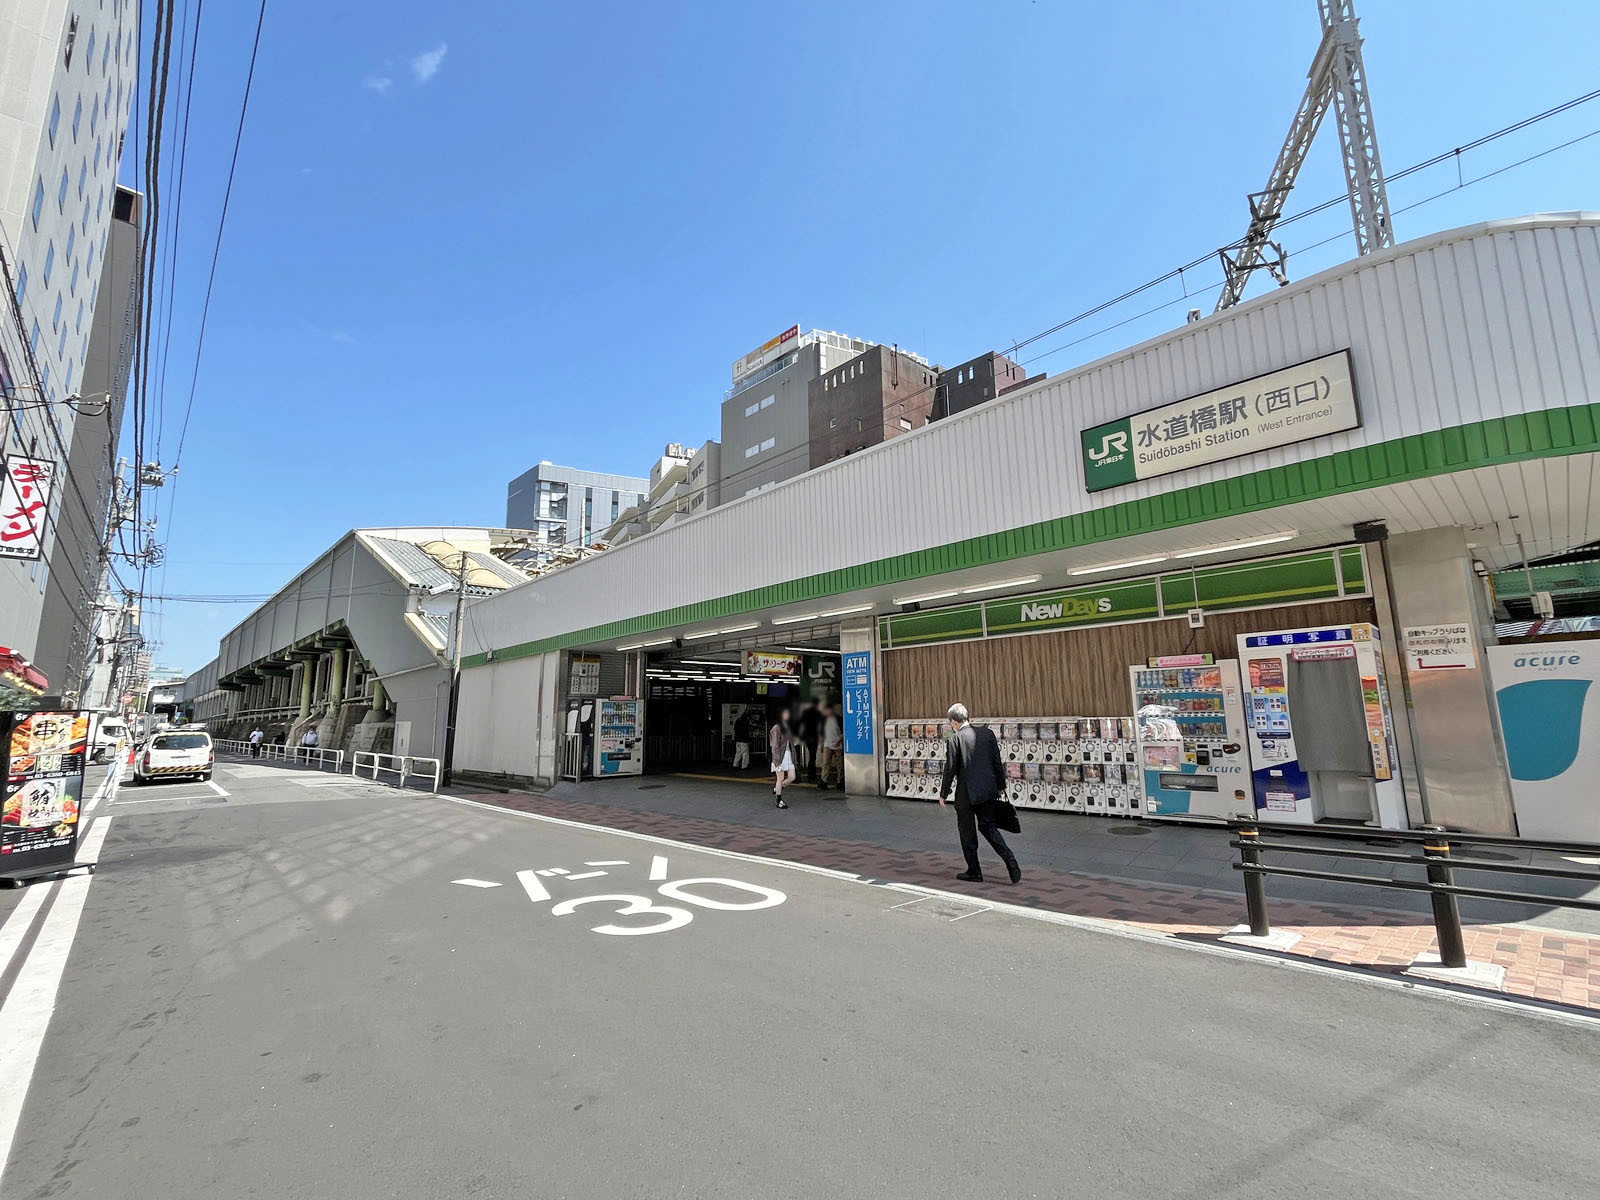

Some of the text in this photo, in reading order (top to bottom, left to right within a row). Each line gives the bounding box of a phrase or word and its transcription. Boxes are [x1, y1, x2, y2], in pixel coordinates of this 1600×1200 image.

[1139, 405, 1333, 464] Suidōbashi Station (West Entrance)
[1088, 430, 1129, 460] JR
[1094, 454, 1125, 468] JR東日本
[1020, 597, 1112, 622] NewDays
[1257, 629, 1348, 646] 証明写真
[846, 657, 867, 669] ATM
[1514, 655, 1581, 667] acure
[808, 661, 836, 679] JR
[15, 713, 27, 721] 6F
[863, 689, 871, 741] ATMコーナー
[1206, 765, 1242, 774] acure
[6, 785, 19, 793] 6F
[552, 878, 787, 936] 30
